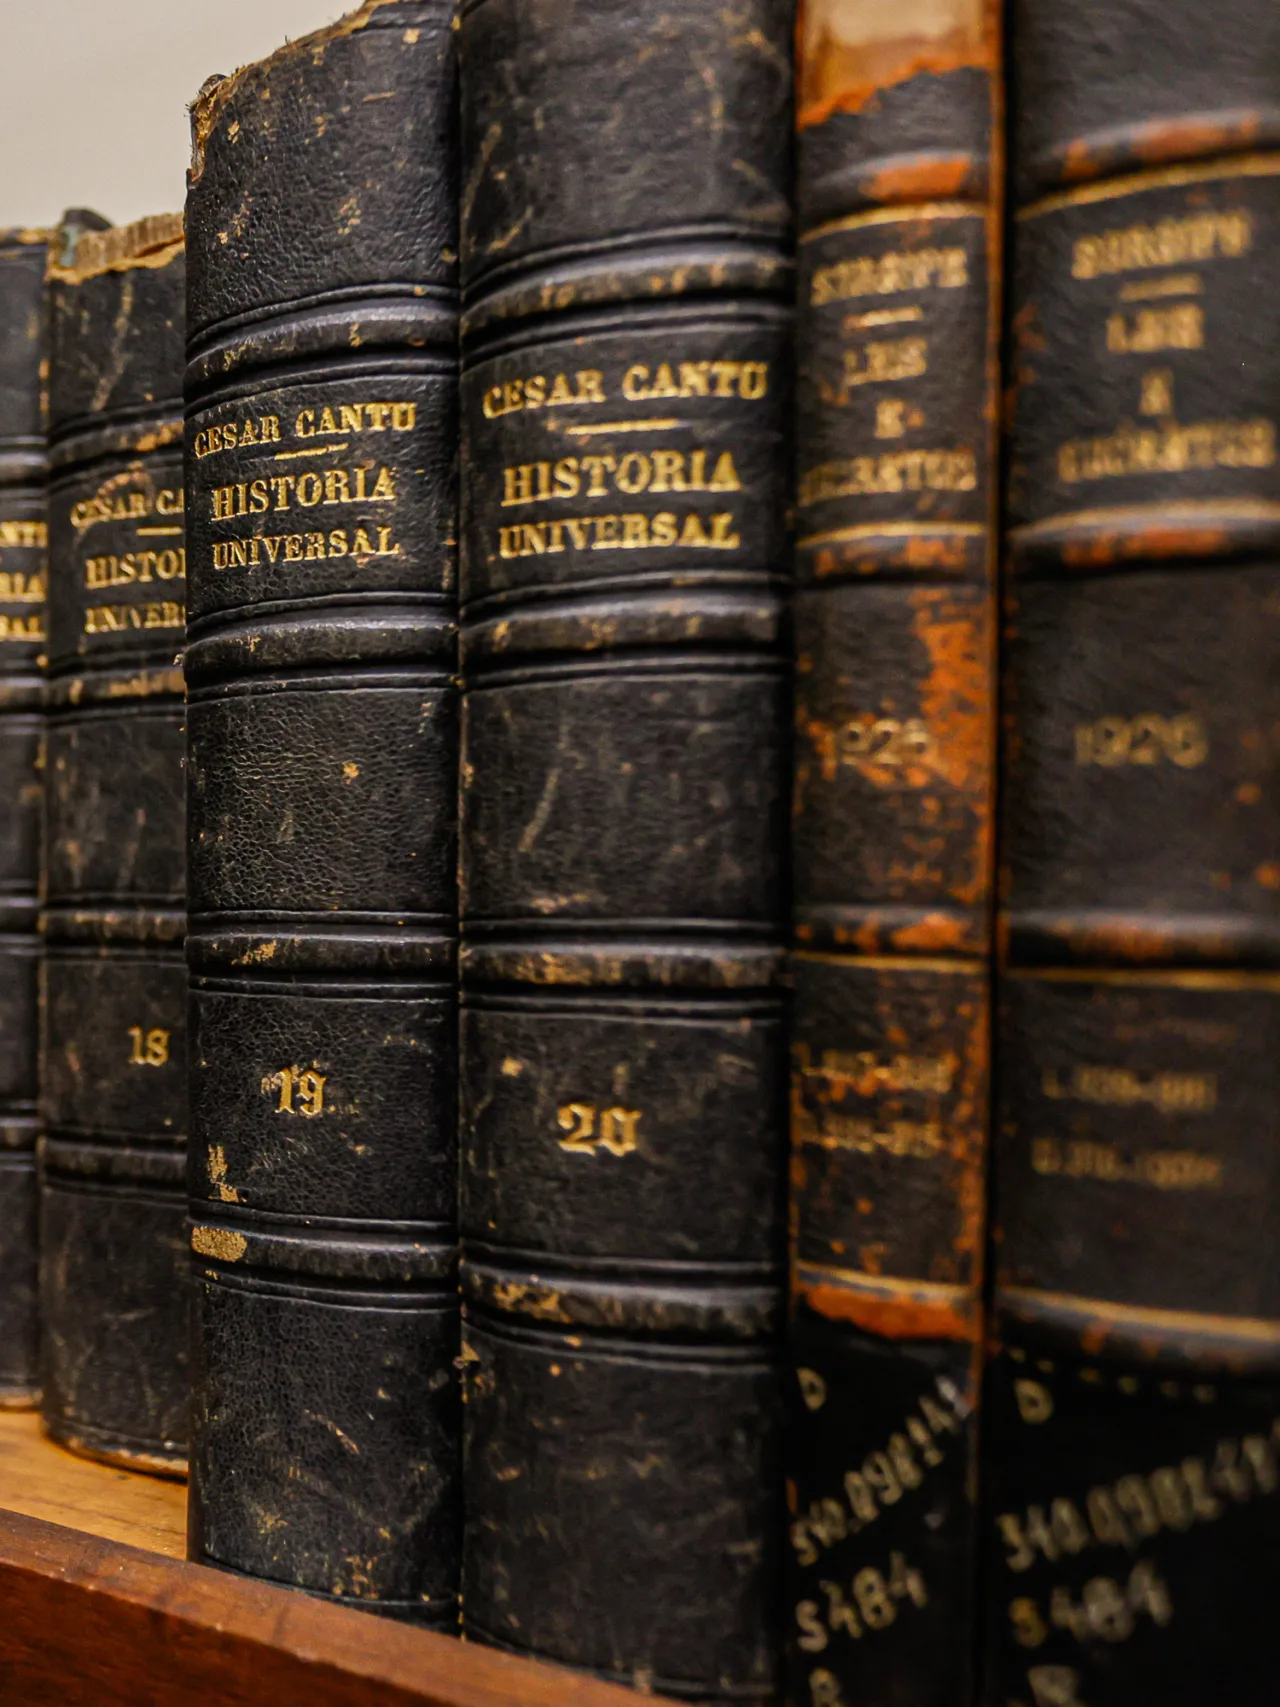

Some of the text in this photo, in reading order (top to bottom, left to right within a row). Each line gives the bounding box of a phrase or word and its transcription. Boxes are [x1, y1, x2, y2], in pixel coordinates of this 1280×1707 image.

[484, 362, 768, 419] CESAR CANTU
[194, 403, 417, 458] CESAR CANTU
[212, 466, 397, 521] HISTORIA
[502, 452, 743, 506] HISTORIA
[213, 526, 400, 570] UNIVERSAL
[499, 513, 741, 559] UNIVERSAL
[128, 1025, 171, 1067] 18
[275, 1067, 327, 1116] 19
[557, 1103, 645, 1157] 20
